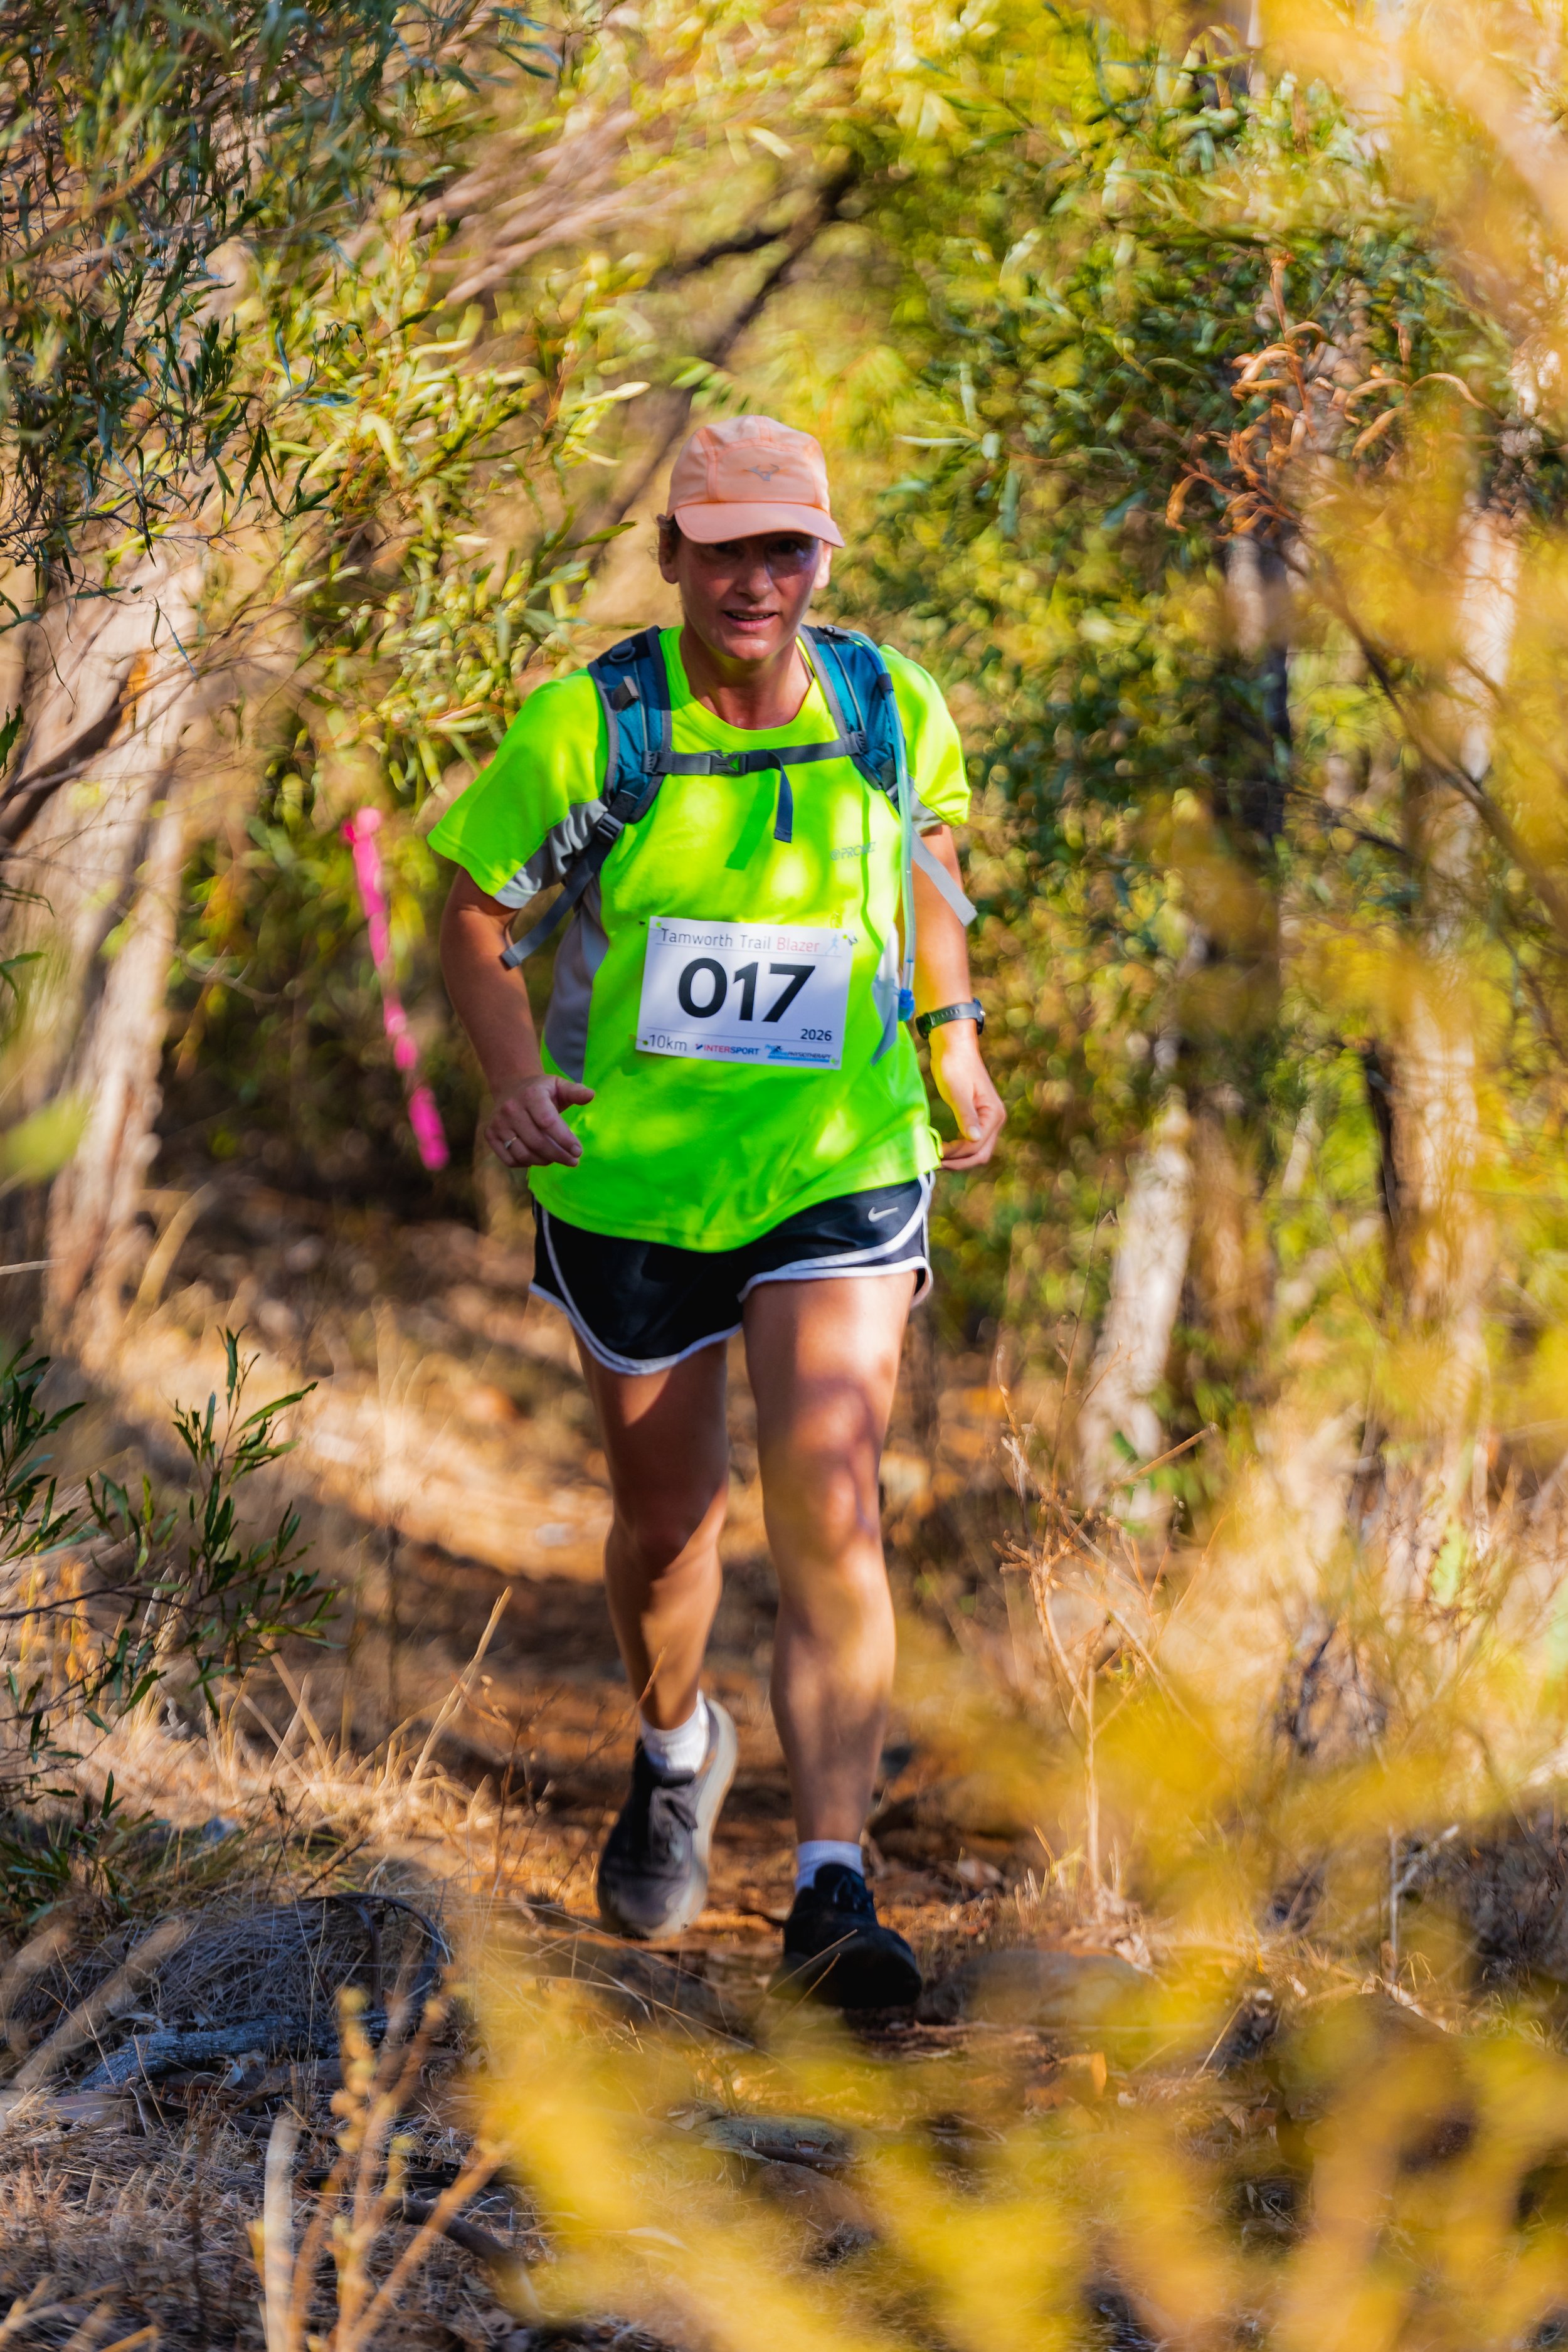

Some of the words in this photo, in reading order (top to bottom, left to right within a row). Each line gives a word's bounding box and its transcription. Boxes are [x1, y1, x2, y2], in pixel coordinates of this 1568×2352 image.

[661, 928, 733, 947] Tamworth
[740, 935, 771, 950] Trail
[776, 937, 820, 953] Blazer
[678, 958, 816, 1022] 017
[649, 1034, 687, 1051] 10km
[800, 1029, 832, 1041] 2026
[703, 1044, 760, 1055] INTERSPORT
